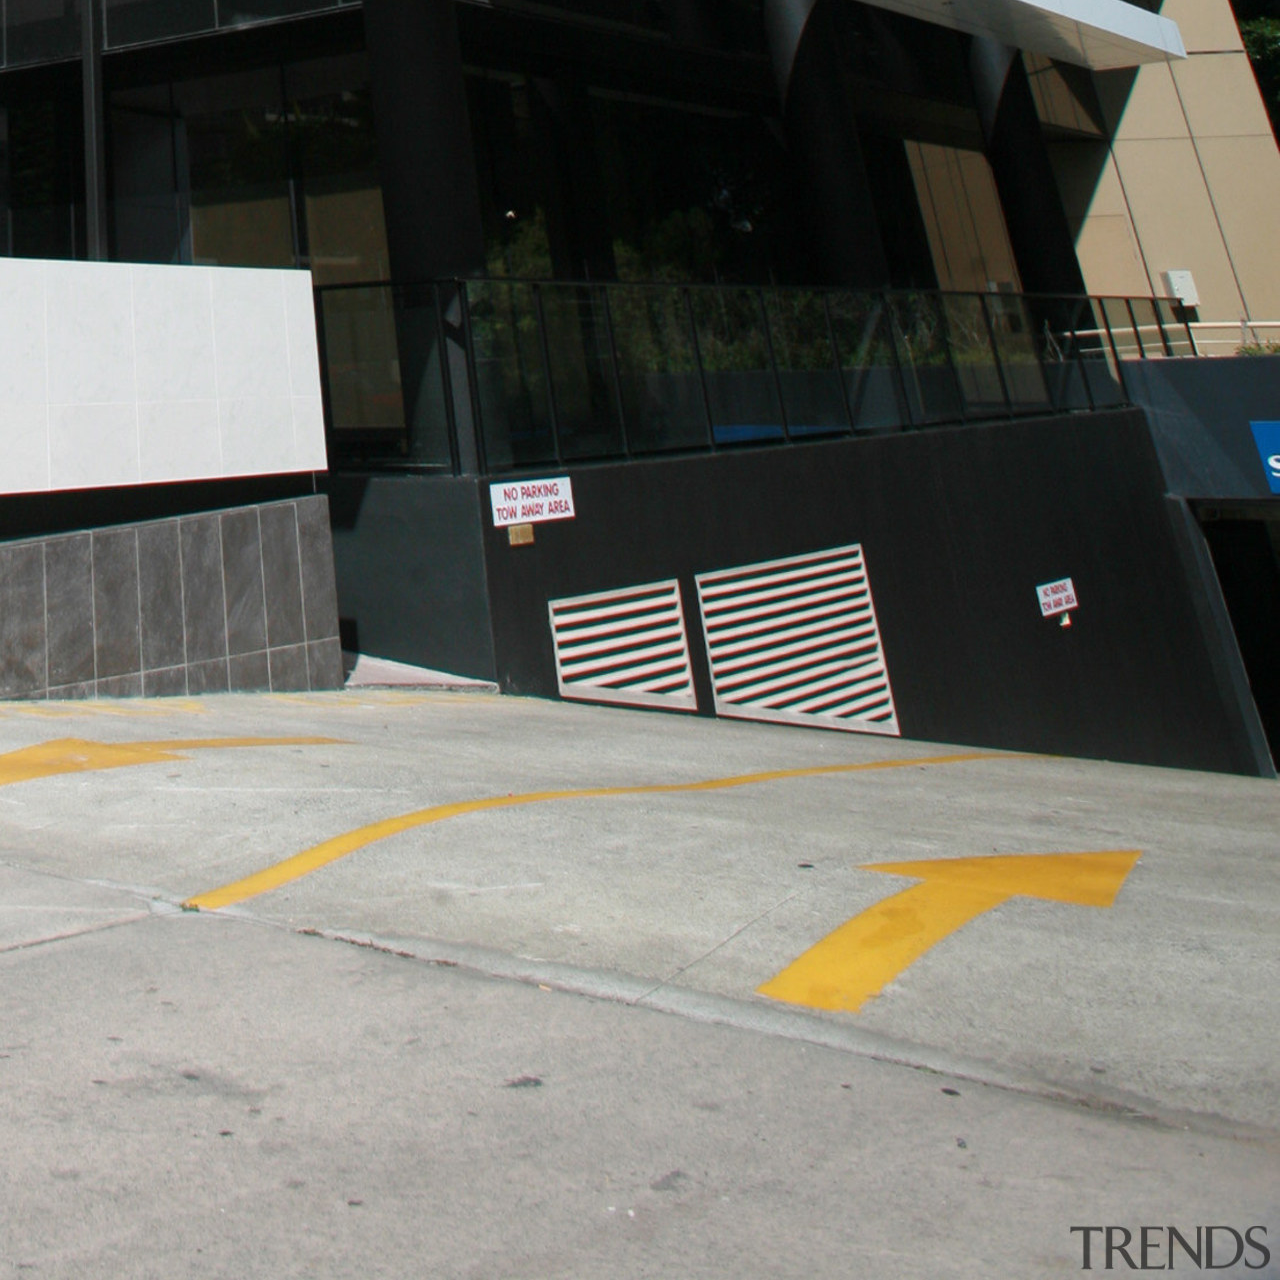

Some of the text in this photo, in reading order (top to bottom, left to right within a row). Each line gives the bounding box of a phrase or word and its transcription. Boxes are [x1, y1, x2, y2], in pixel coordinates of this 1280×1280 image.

[503, 482, 559, 501] NO PARKING
[496, 499, 571, 521] TOW AWAY AREA
